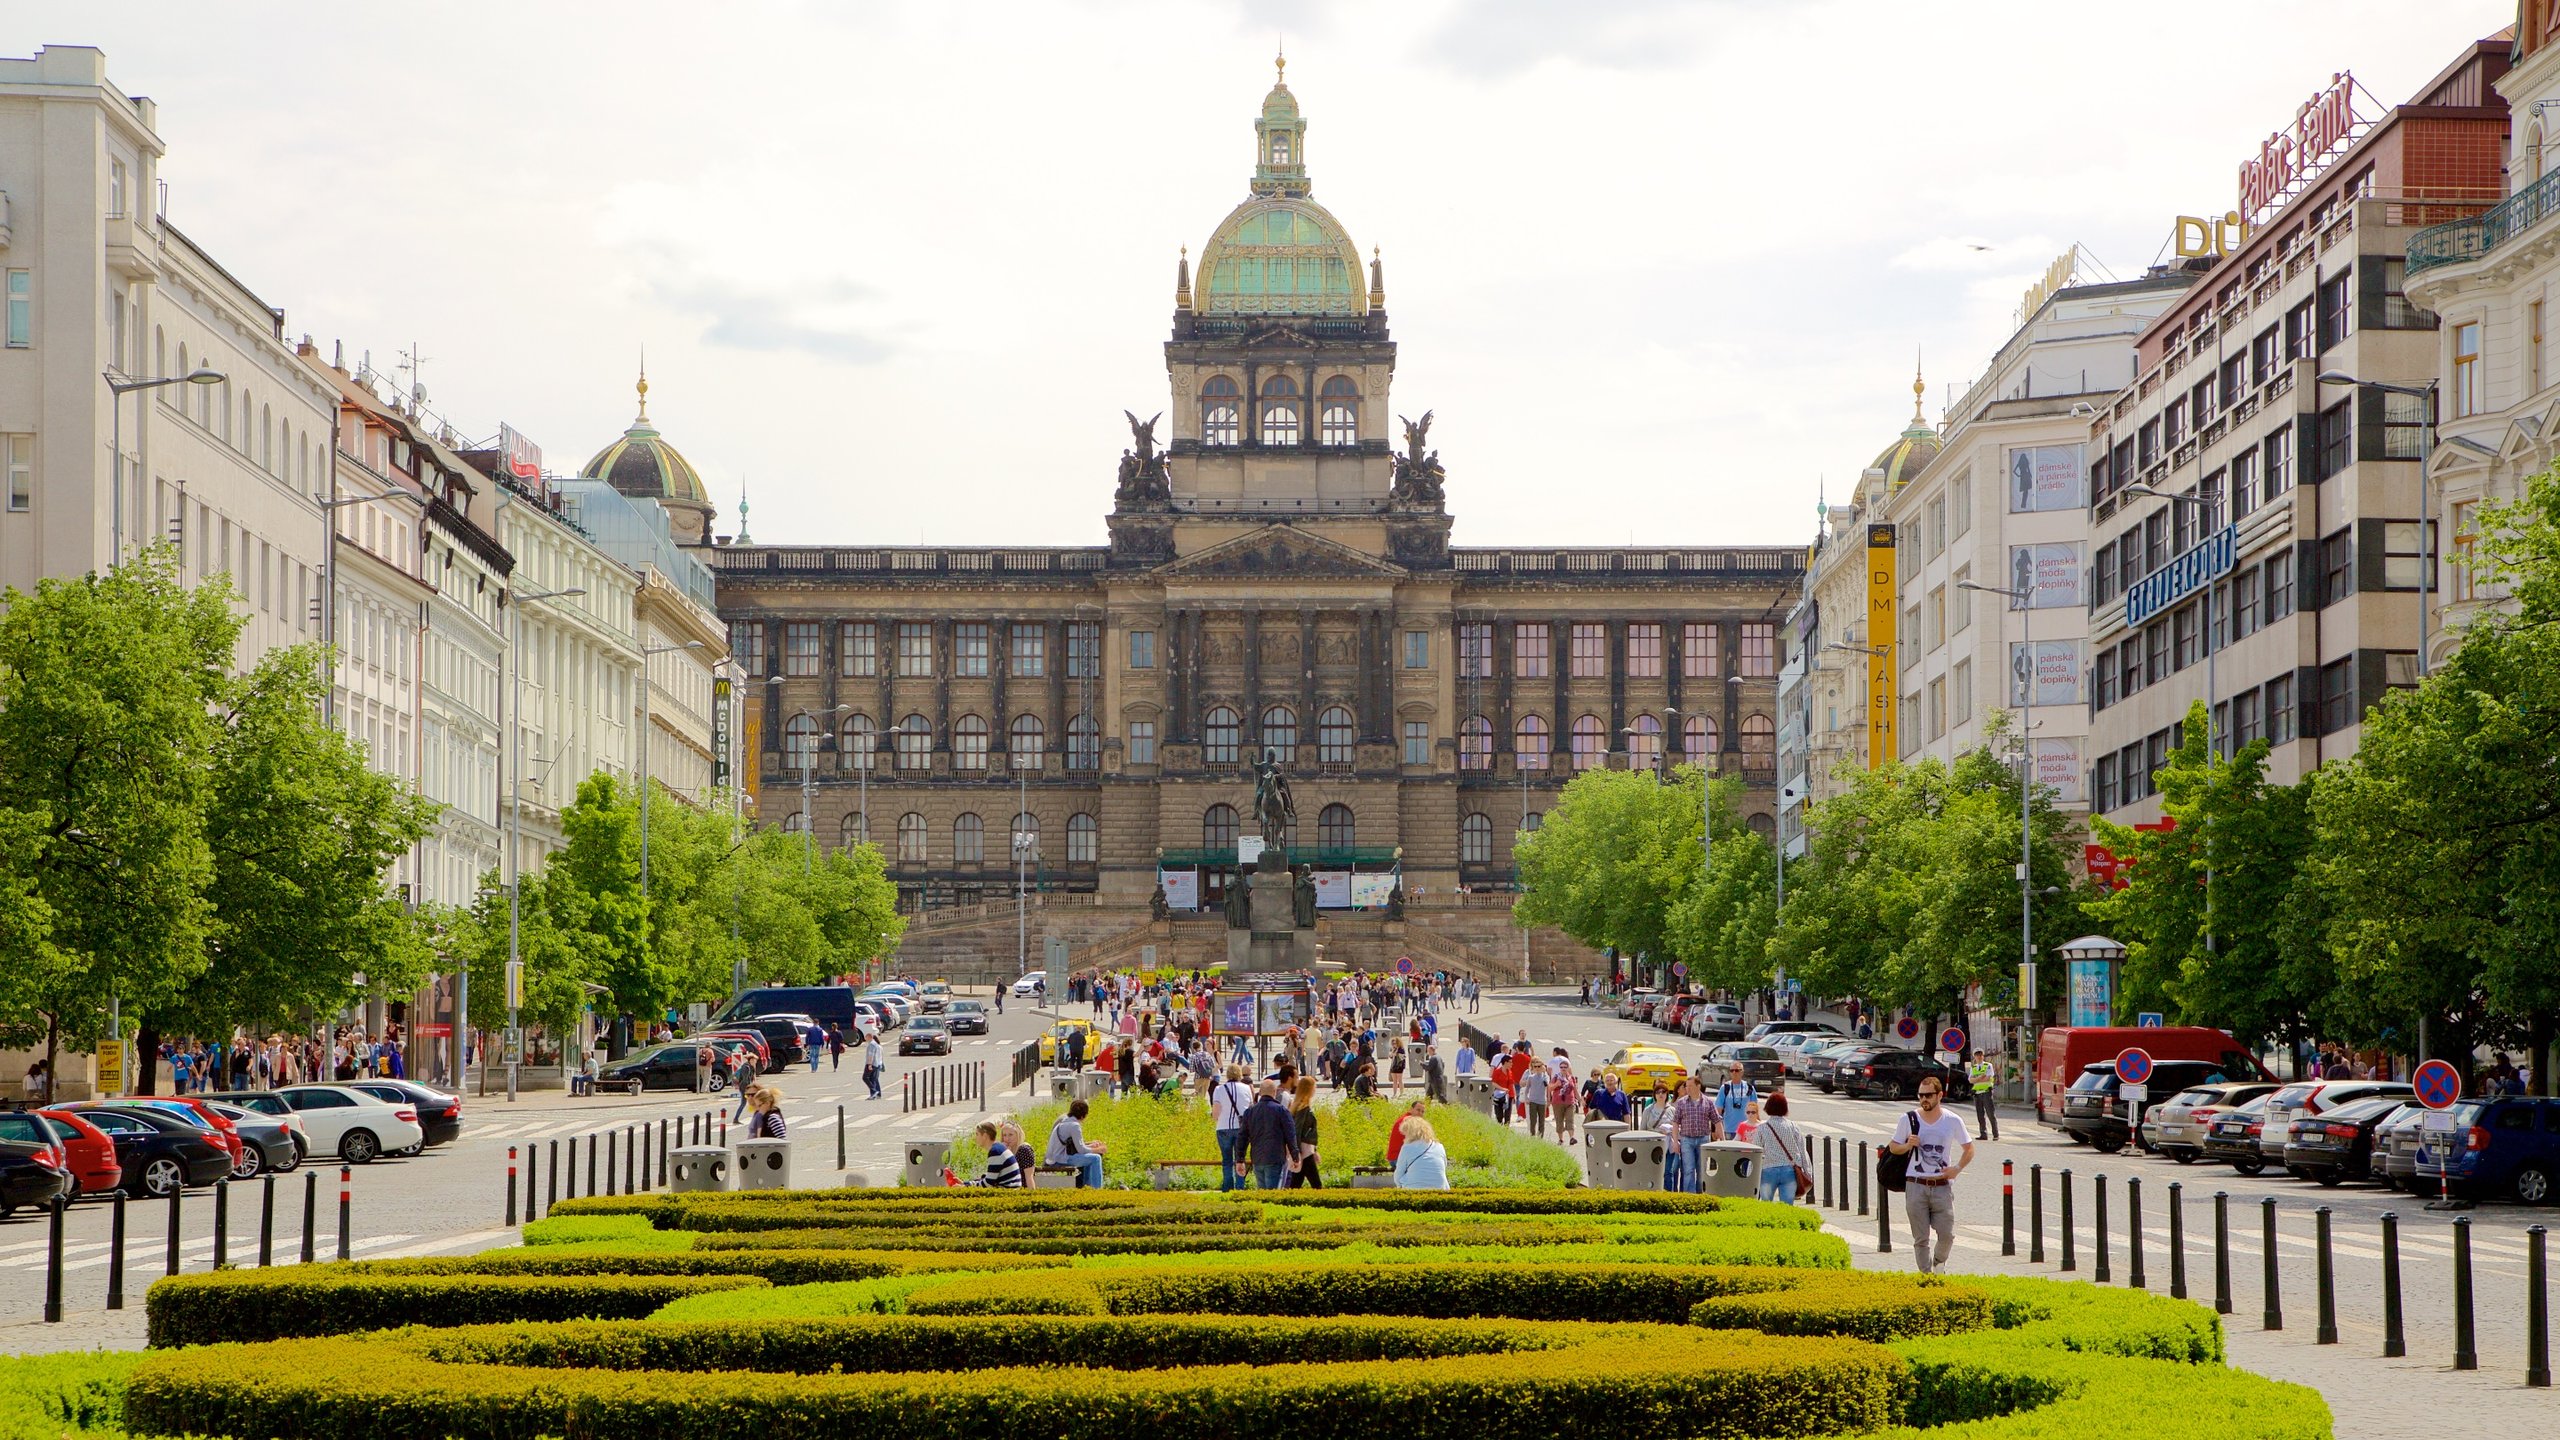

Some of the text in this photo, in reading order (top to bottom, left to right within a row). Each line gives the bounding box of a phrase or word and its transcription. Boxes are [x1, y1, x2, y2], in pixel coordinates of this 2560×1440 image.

[2239, 73, 2354, 225] Palác Fénix
[2040, 652, 2074, 663] pánská
[2040, 674, 2077, 685] doplňky
[2040, 752, 2077, 762] dámská
